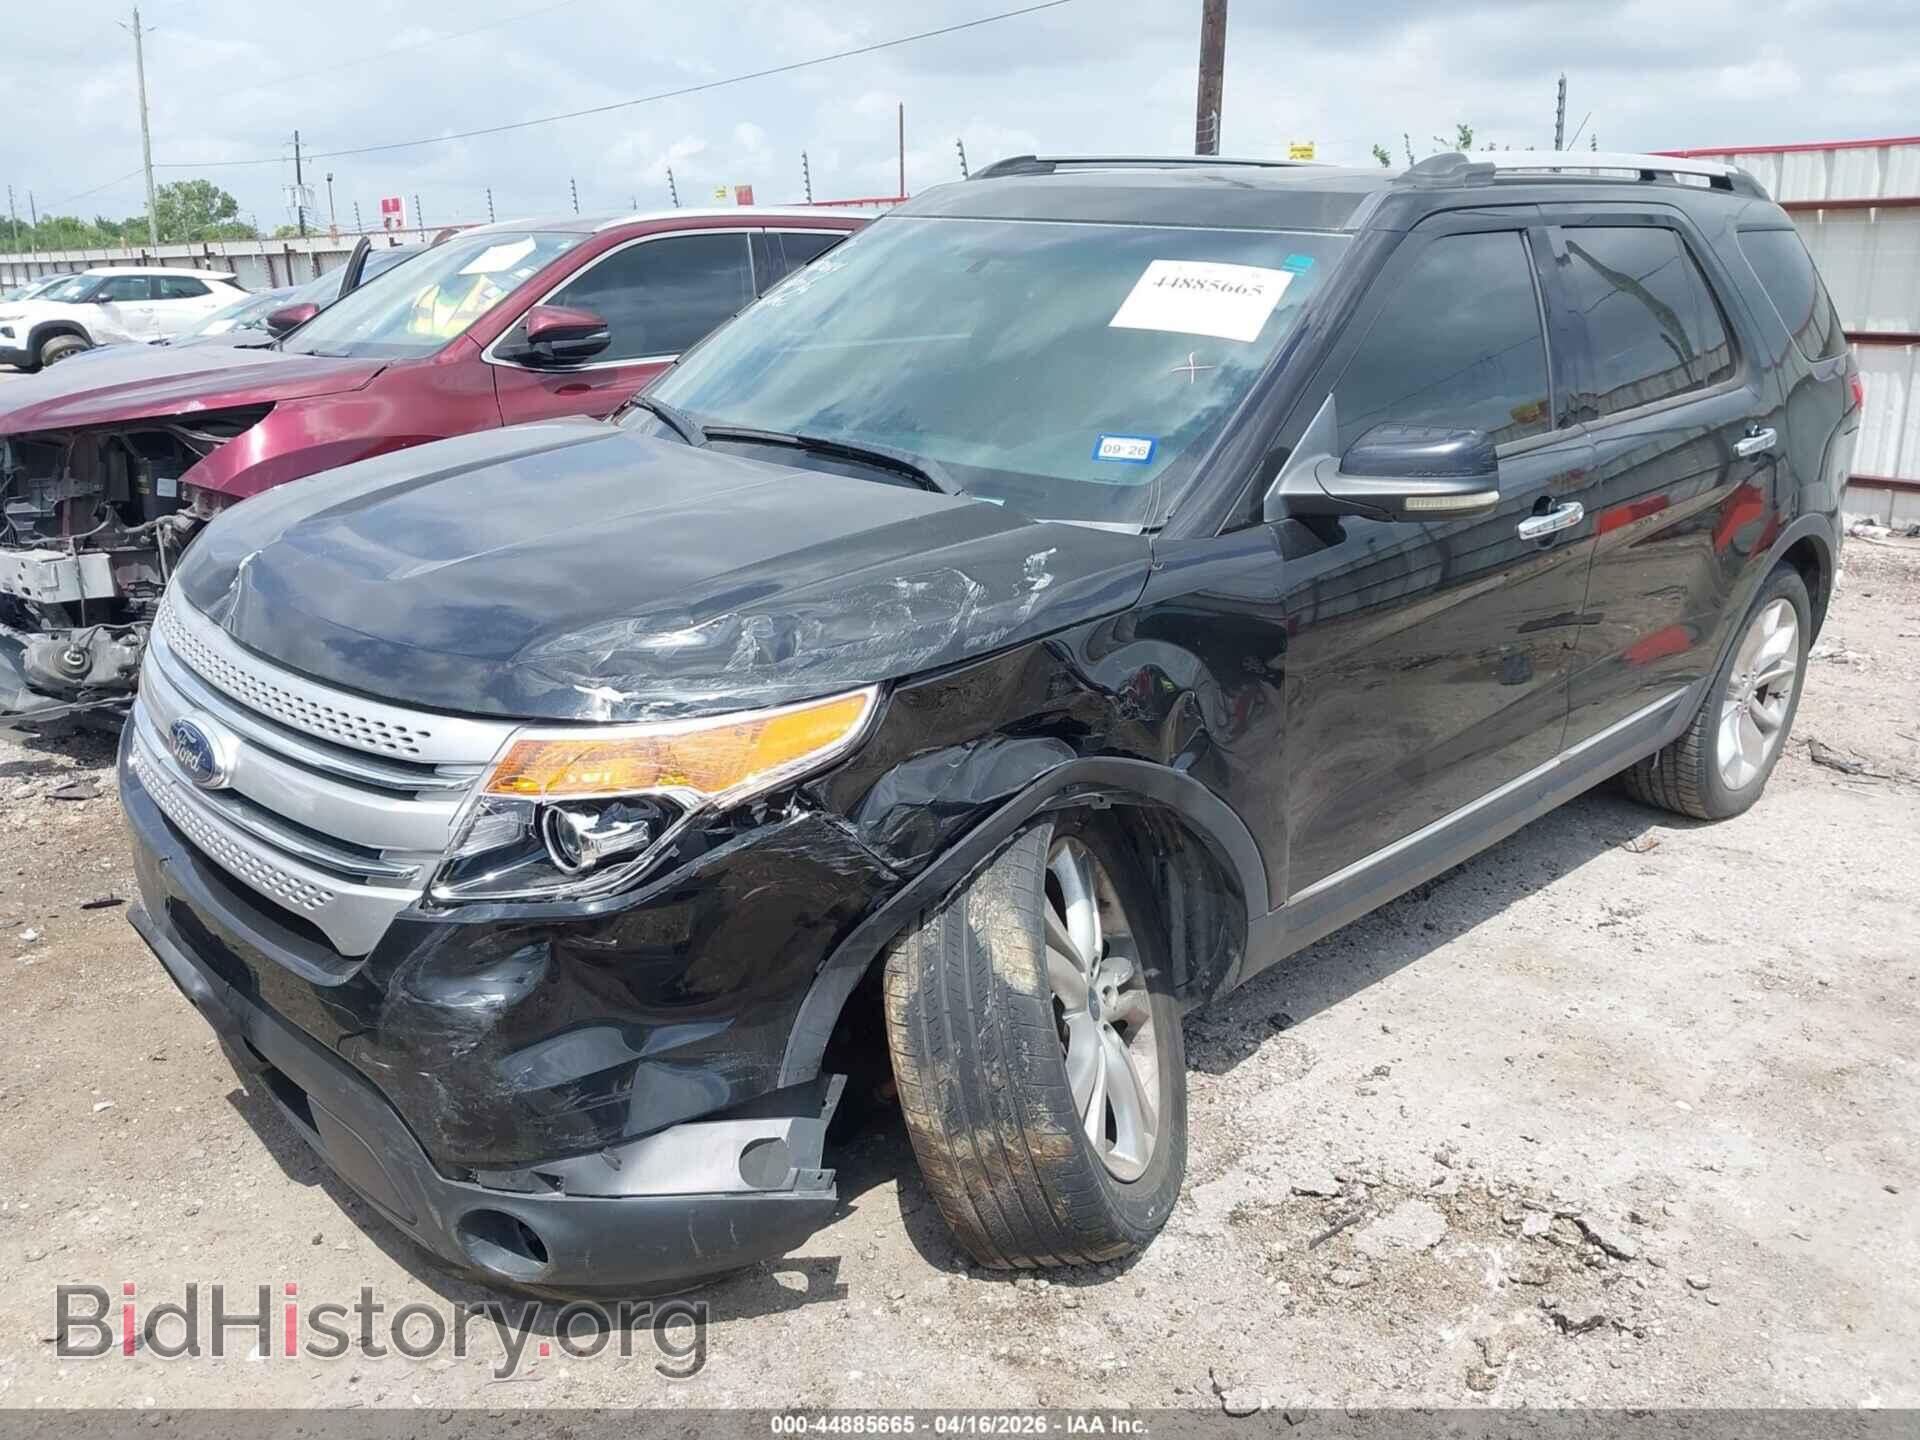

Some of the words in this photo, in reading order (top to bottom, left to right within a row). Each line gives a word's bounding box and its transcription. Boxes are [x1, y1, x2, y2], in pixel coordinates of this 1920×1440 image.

[1153, 275, 1265, 296] 44885665
[1103, 444, 1120, 455] 09
[1128, 445, 1147, 456] 26
[173, 727, 203, 772] Ford
